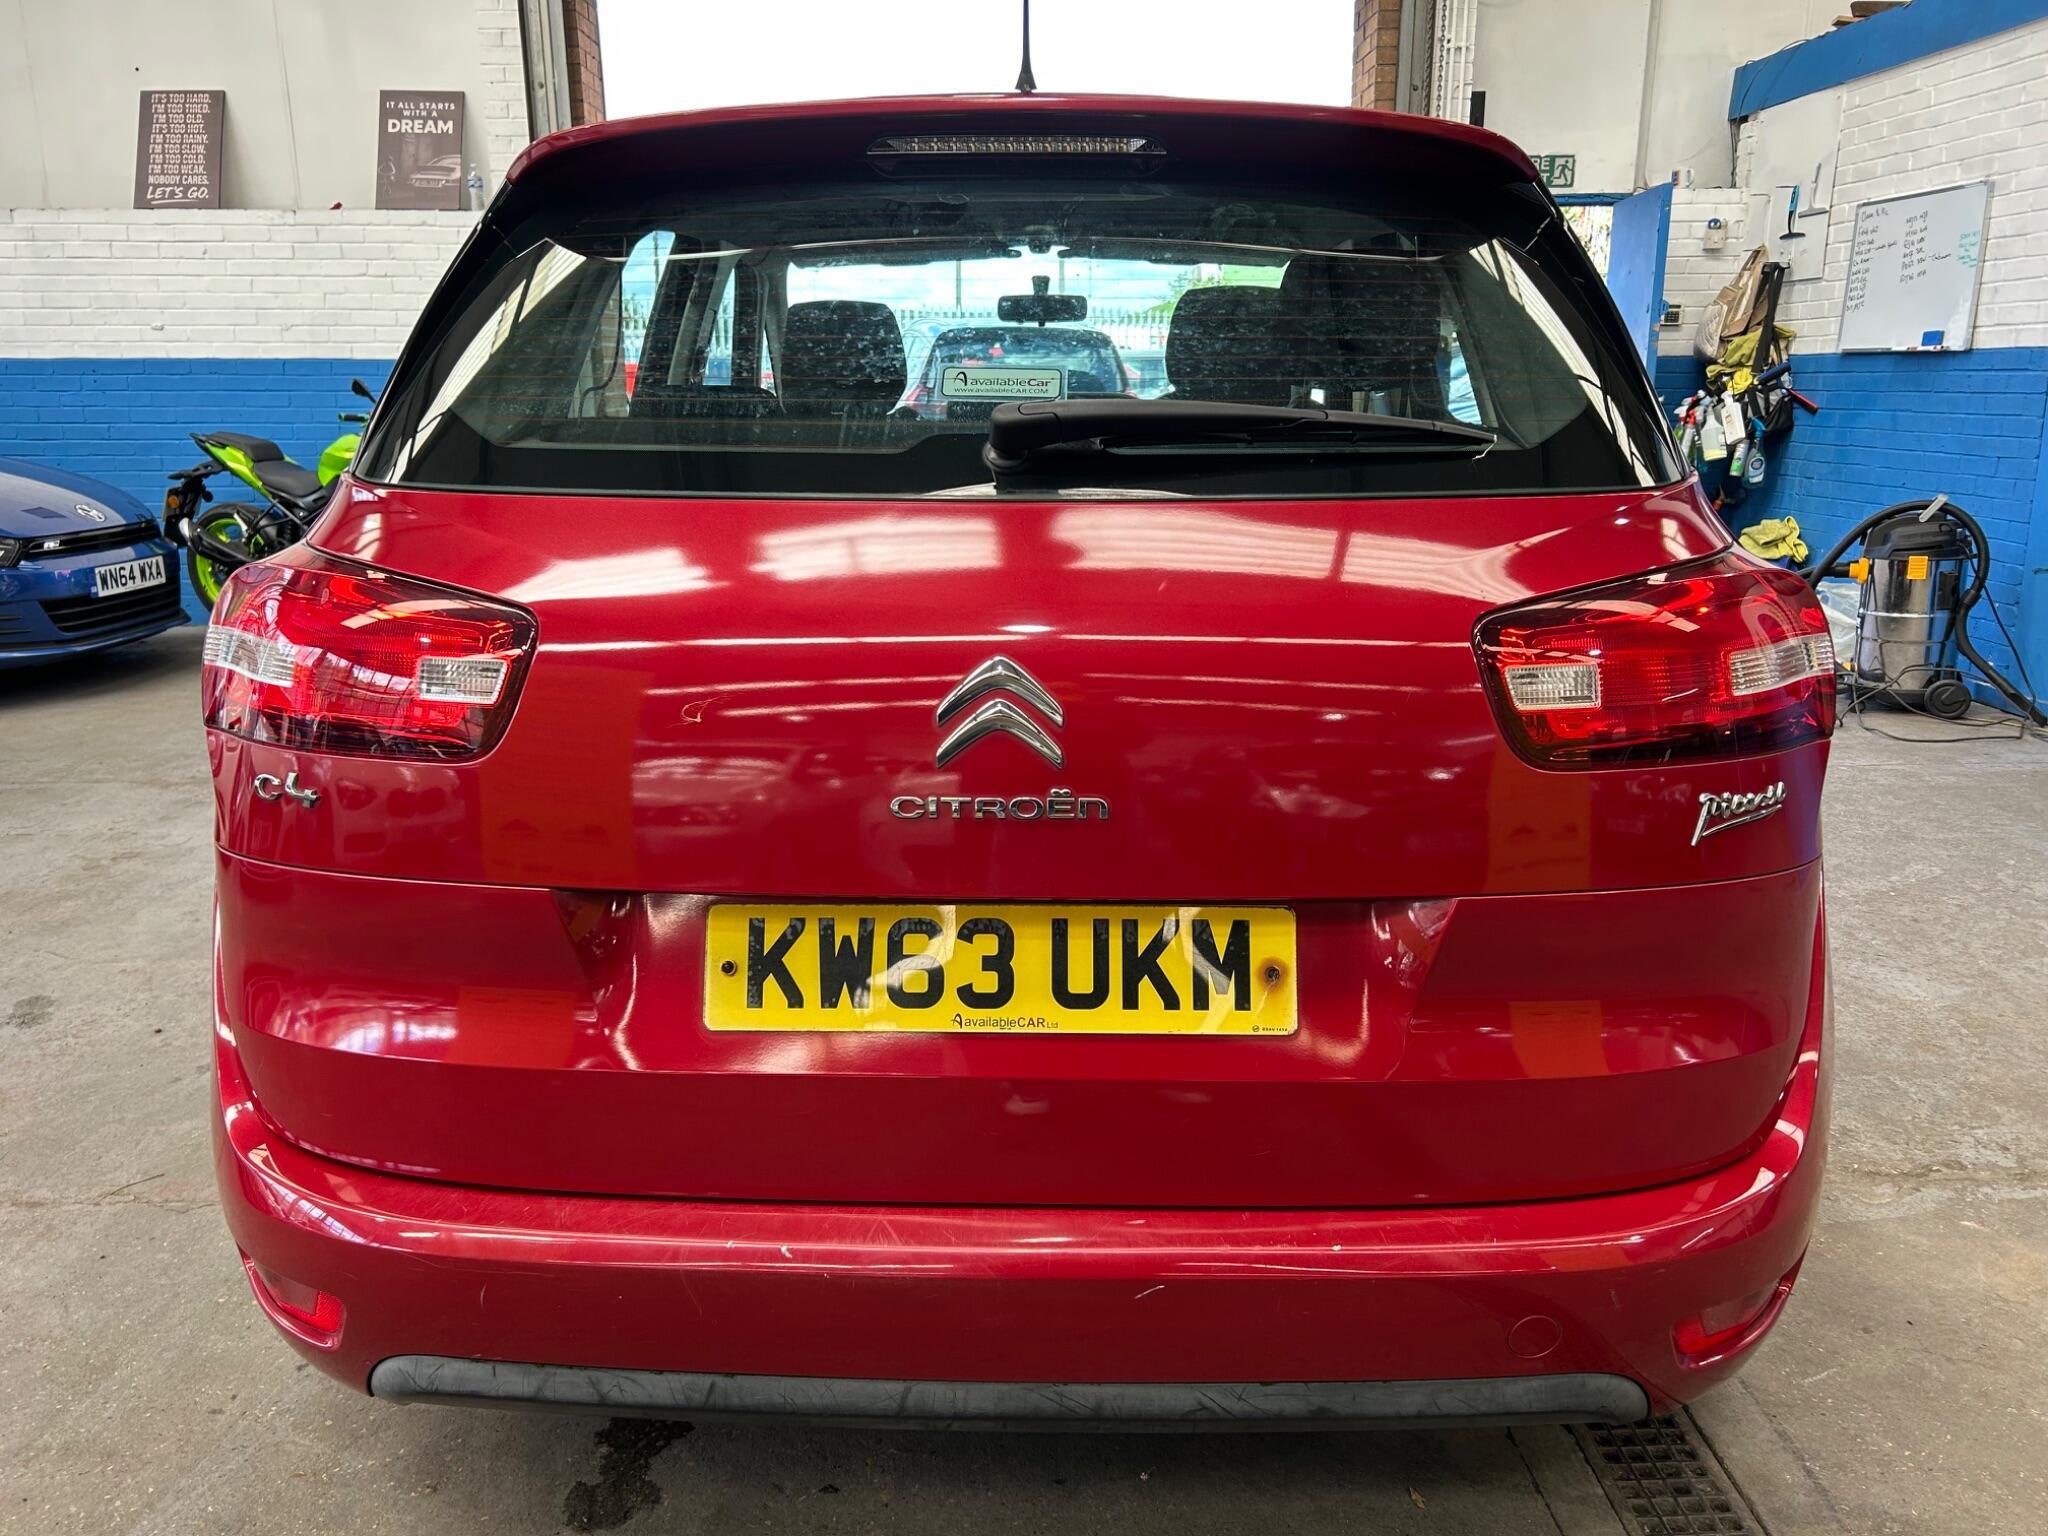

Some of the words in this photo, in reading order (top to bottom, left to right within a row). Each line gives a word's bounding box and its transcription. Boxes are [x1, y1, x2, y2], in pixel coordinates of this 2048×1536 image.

[169, 94, 185, 103] TOO
[186, 94, 211, 103] HARD.
[152, 104, 165, 113] I'M
[167, 104, 183, 113] TOO
[185, 104, 210, 113] TIRED.
[386, 101, 395, 109] IT
[419, 102, 455, 110] STARTS
[153, 114, 166, 123] I'M
[168, 114, 184, 123] TOO
[186, 114, 204, 123] OLD.
[169, 124, 185, 133] TOO
[387, 119, 454, 134] DREAM
[165, 134, 181, 143] TOO
[183, 134, 208, 143] RAINY.
[149, 144, 162, 153] I'M
[164, 144, 180, 153] TOO
[182, 144, 206, 153] SLOW.
[165, 154, 181, 163] TOO
[182, 154, 206, 163] COLD.
[148, 165, 161, 174] I'M
[163, 165, 179, 174] TOO
[181, 165, 206, 174] WEAK.
[148, 175, 180, 184] NOBODY
[182, 175, 209, 184] CARES.
[146, 185, 183, 199] LET'S
[187, 187, 209, 199] GO.
[99, 564, 136, 591] WN64
[138, 559, 163, 583] WXA
[254, 772, 320, 808] C4
[746, 917, 1015, 1010] KW63
[1051, 918, 1252, 1011] UKM
